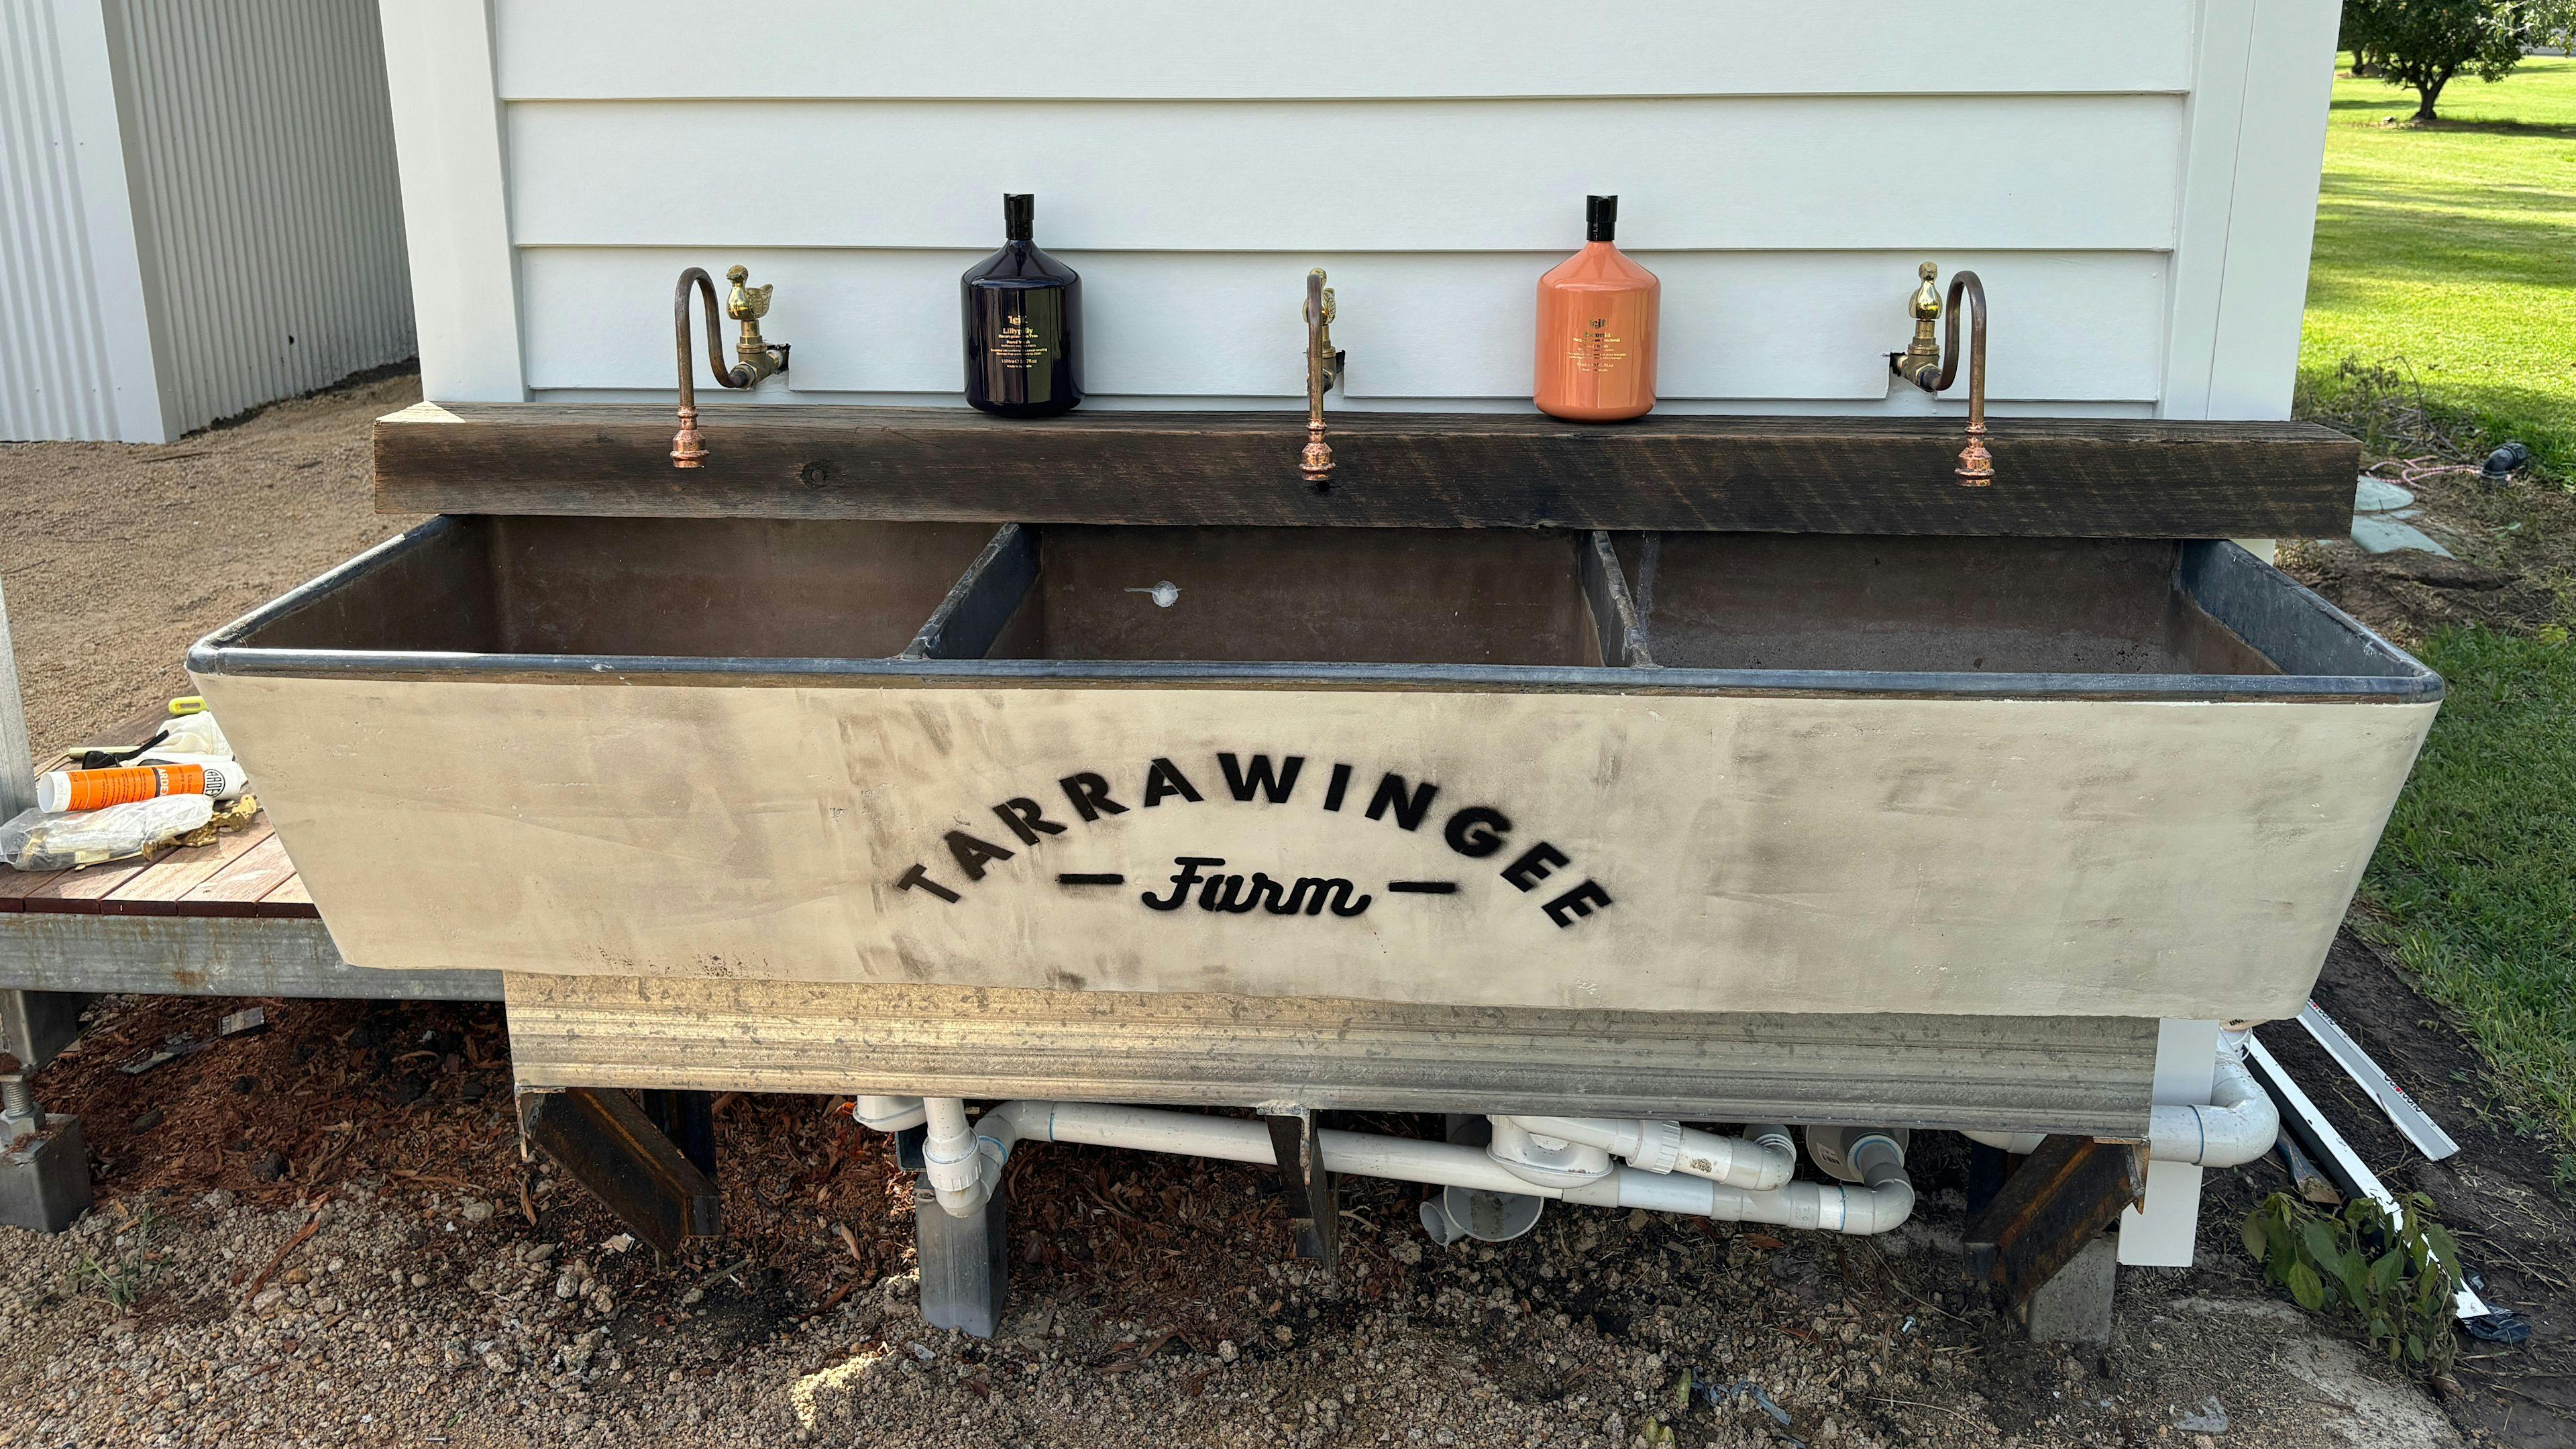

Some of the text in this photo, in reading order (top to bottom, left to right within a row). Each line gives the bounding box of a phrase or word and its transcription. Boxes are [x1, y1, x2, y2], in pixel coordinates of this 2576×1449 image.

[1002, 327, 1034, 335] Lillyplly
[896, 753, 1613, 928] TARRAWINGEE
[1142, 857, 1372, 918] Farm
